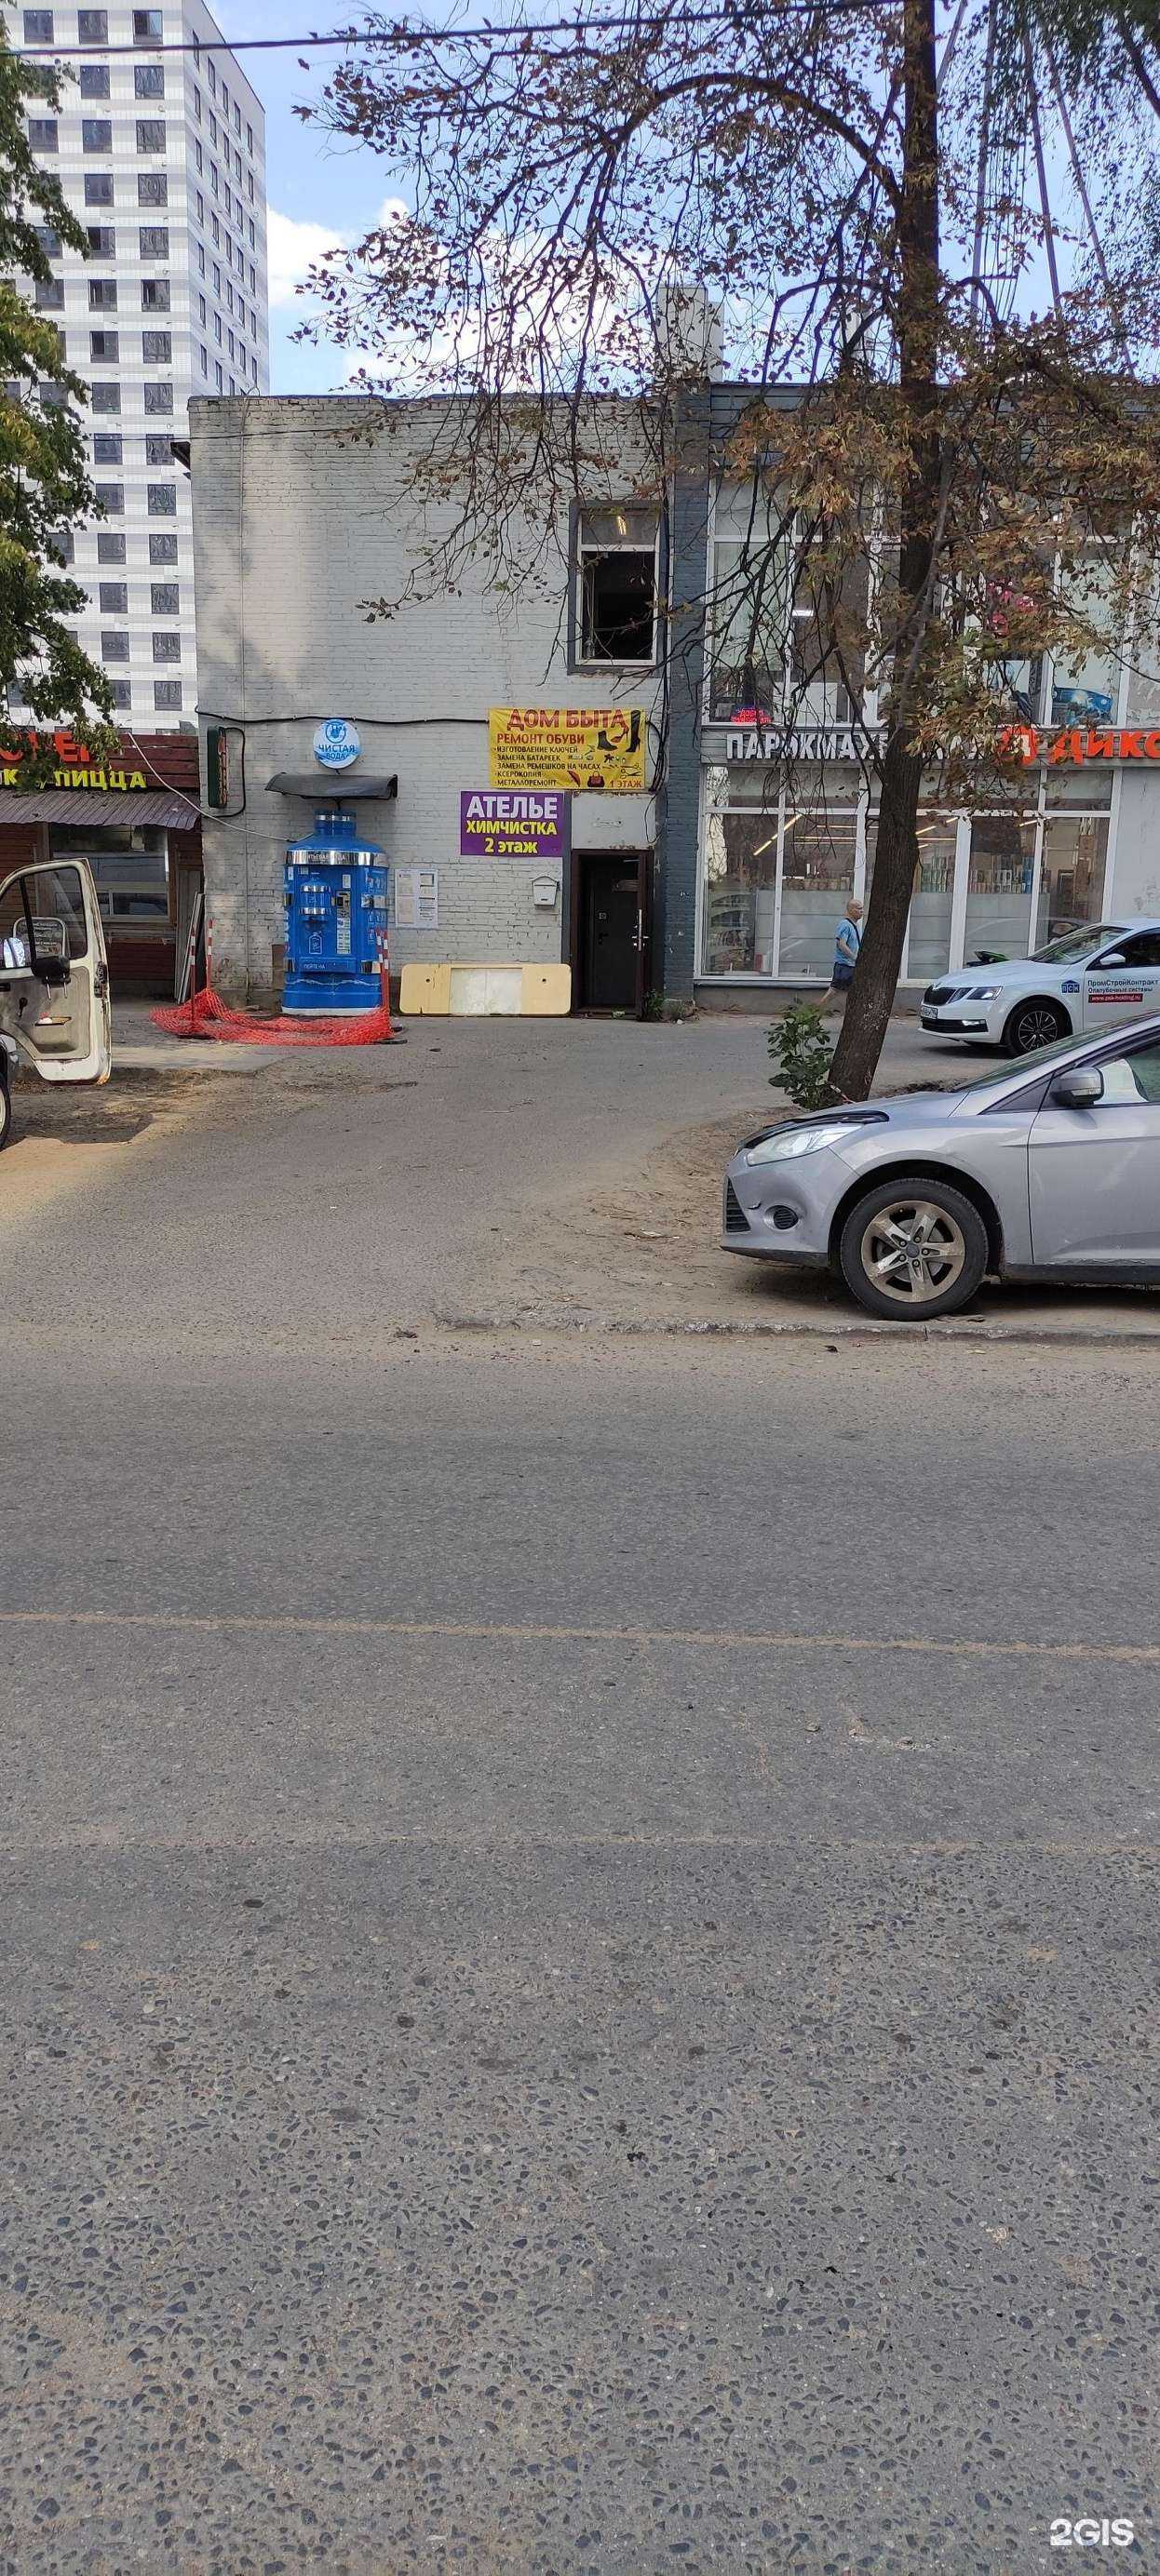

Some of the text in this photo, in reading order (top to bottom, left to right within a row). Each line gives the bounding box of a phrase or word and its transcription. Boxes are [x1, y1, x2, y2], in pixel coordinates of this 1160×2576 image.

[506, 708, 626, 731] ДОМ БЫТА
[497, 733, 585, 745] РЕМОНТ ОБУВИ
[318, 744, 355, 753] ЧИСТАЯ
[54, 770, 147, 791] ПИЦЦА
[610, 780, 642, 788] 1 ЭТАЖ
[466, 796, 558, 819] АТЕЛЬЕ
[466, 820, 558, 836] ХИМЧИСТКА
[484, 838, 538, 853] 2 этаж
[1087, 979, 1159, 988] ПромСтройКонтракт
